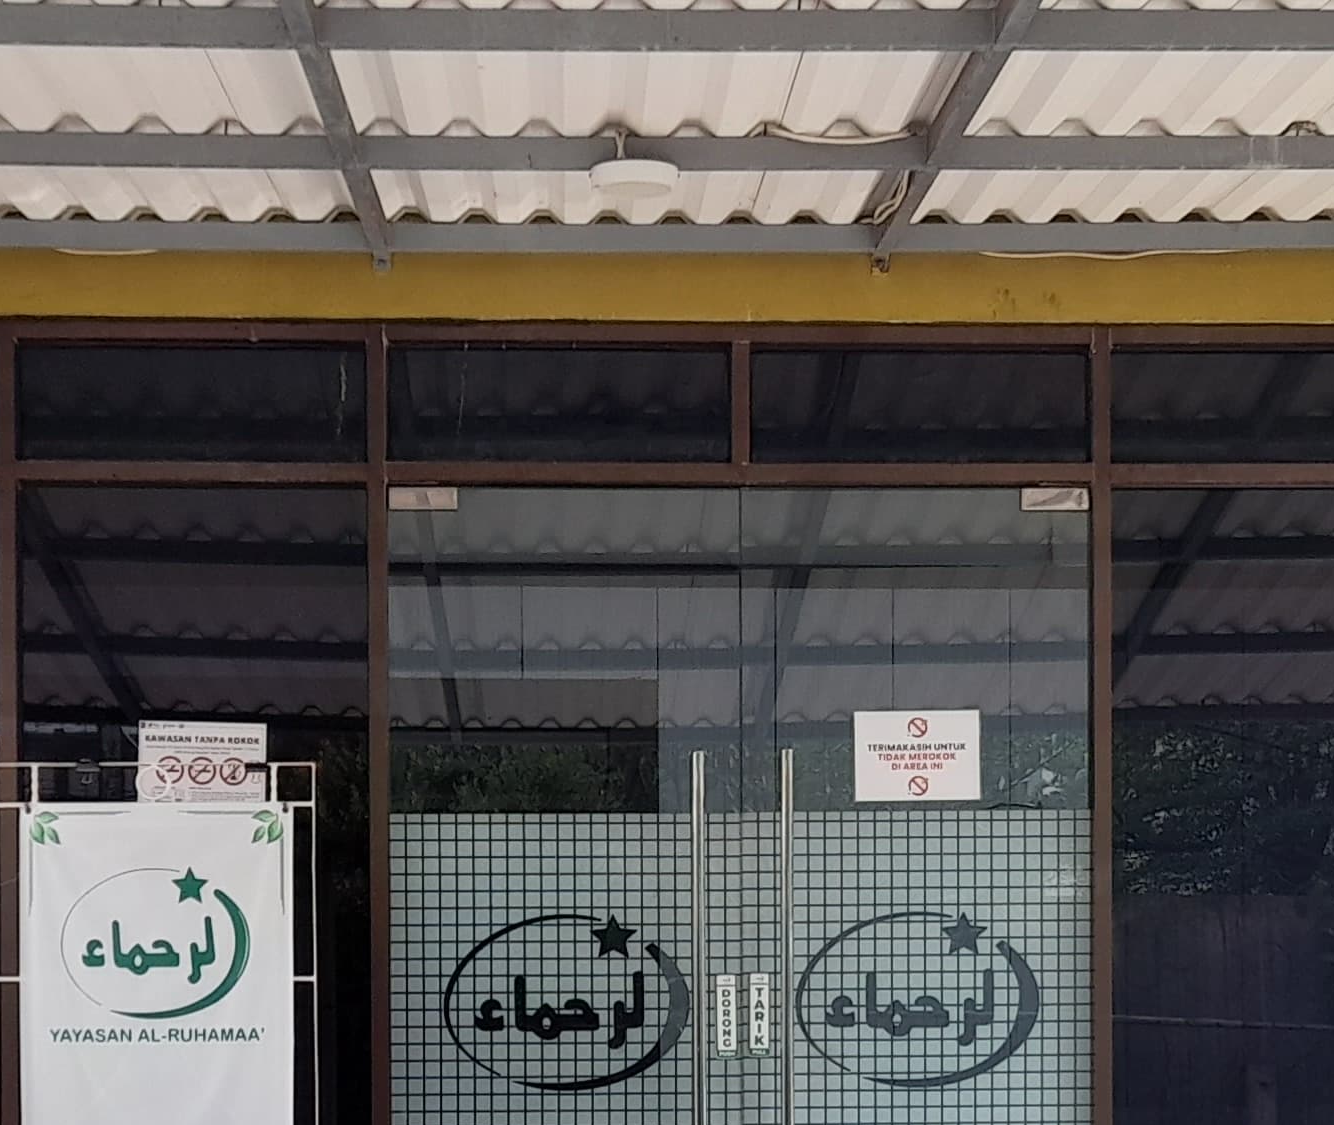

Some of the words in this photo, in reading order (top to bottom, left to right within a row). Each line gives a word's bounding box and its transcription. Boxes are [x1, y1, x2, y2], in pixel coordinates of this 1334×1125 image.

[145, 735, 192, 743] KAWASAN
[195, 736, 226, 744] TANPA
[227, 737, 260, 745] ROKOK
[867, 743, 932, 752] TERIMAKASIH
[934, 743, 966, 751] UNTUK
[878, 753, 906, 761] TIDAK
[908, 753, 957, 761] MEROKOK
[903, 762, 928, 770] AREA
[930, 762, 943, 770] INI
[721, 989, 732, 1048] DORONG
[753, 987, 765, 1046] TARIK
[49, 1028, 133, 1043] YAYASAN
[138, 1027, 266, 1043] AL-RUHAMAA'
